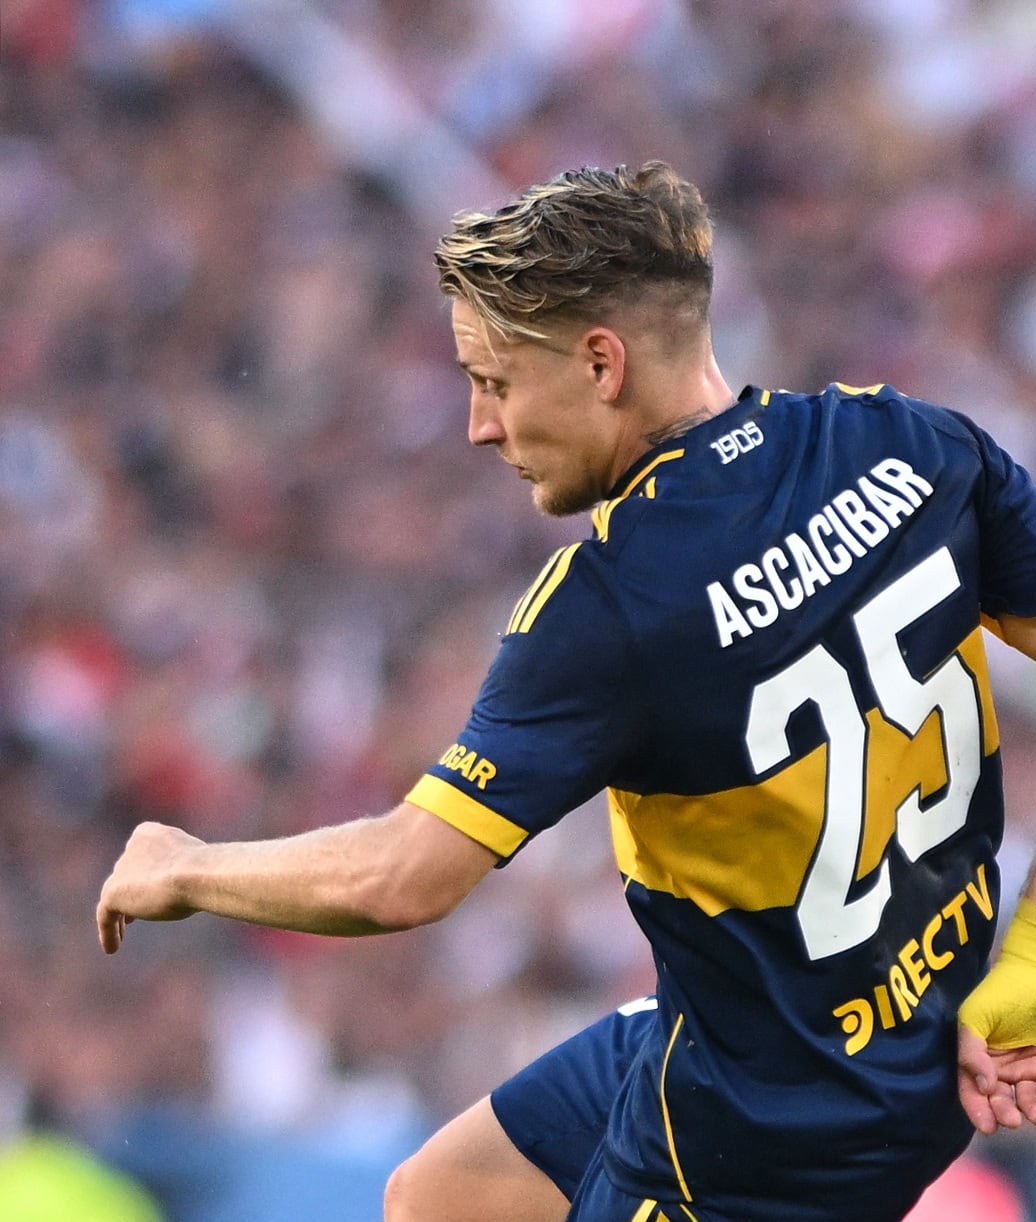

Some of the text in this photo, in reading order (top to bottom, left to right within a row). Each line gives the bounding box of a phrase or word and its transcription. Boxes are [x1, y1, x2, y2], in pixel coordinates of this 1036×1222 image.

[710, 421, 764, 464] 1905
[706, 458, 934, 648] ASCACIBAR
[746, 546, 981, 961] 25
[832, 863, 994, 1056] DIRECTV
